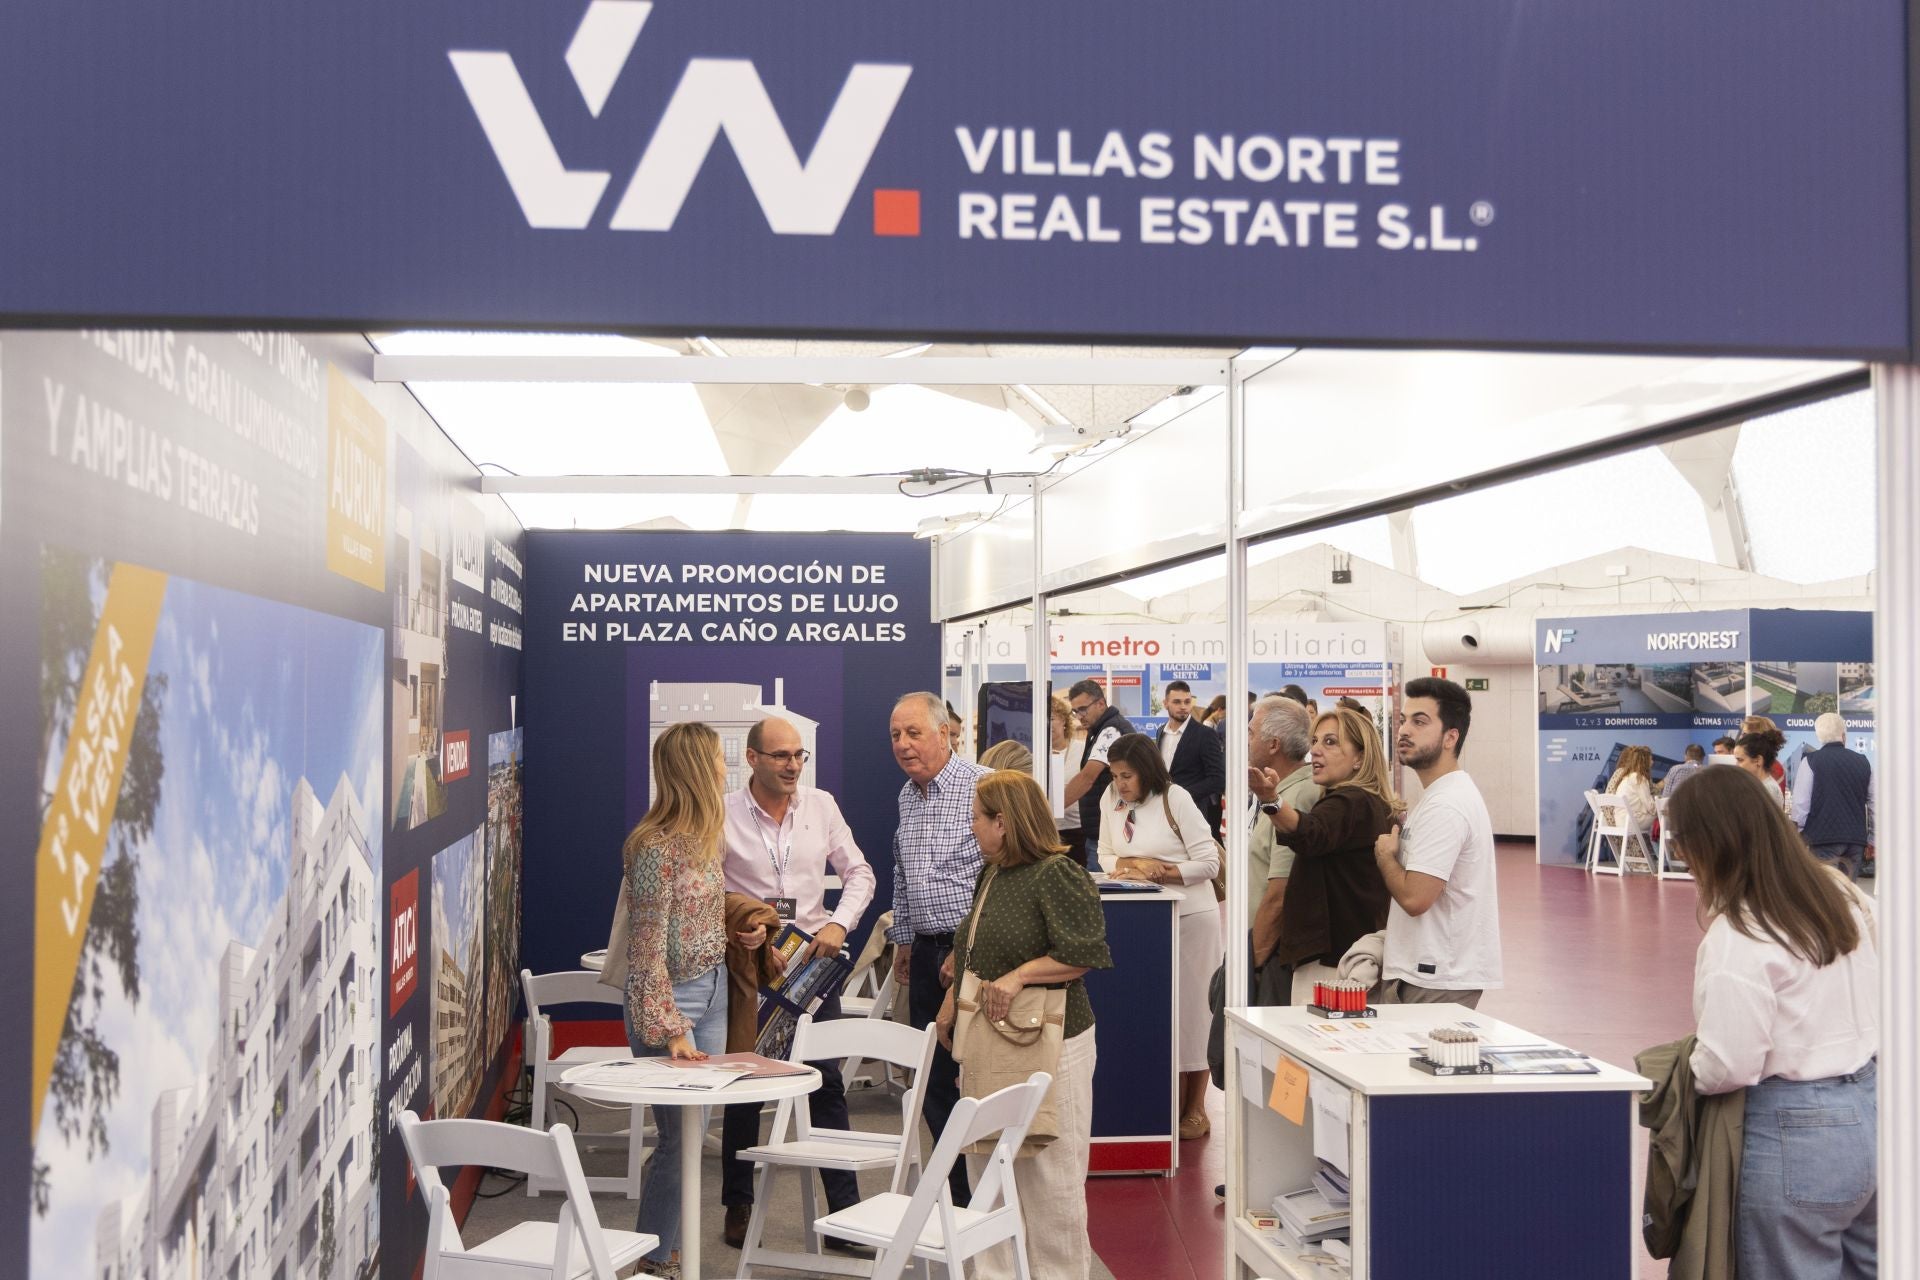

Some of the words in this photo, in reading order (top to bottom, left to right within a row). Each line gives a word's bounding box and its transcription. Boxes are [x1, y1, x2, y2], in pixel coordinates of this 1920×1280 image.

[955, 126, 1174, 179] VILLAS
[1194, 134, 1400, 185] NORTE
[958, 192, 1121, 242] REAL
[1140, 197, 1359, 248] ESTATE
[185, 343, 231, 428] GRAN
[44, 376, 64, 457] Y
[71, 394, 172, 501] AMPLIAS
[177, 446, 259, 536] TERRAZAS
[332, 428, 382, 536] AURUM
[584, 564, 674, 583] NUEVA
[682, 559, 843, 584] PROMOCIÓN
[852, 565, 886, 584] DE
[569, 593, 783, 613] APARTAMENTOS
[791, 593, 825, 613] DE
[833, 593, 899, 613] LUJO
[563, 622, 597, 642] EN
[606, 622, 693, 642] PLAZA
[701, 617, 778, 642] CAÑO
[785, 622, 906, 642] ARGALES
[1647, 630, 1741, 651] NORFOREST
[1081, 635, 1160, 656] metro
[1171, 629, 1366, 656] inmbiliaria
[1162, 663, 1209, 671] HACIENDA
[1172, 671, 1199, 680] SIETE
[68, 663, 110, 820] FASE
[108, 623, 123, 676] A
[1605, 717, 1658, 726] DORMITORIOS
[1693, 716, 1722, 726] ÚLTIMAS
[1786, 718, 1814, 727] CIUDAD
[1571, 752, 1601, 761] ARIZA
[62, 851, 90, 936] LA
[84, 663, 135, 836] VENTA
